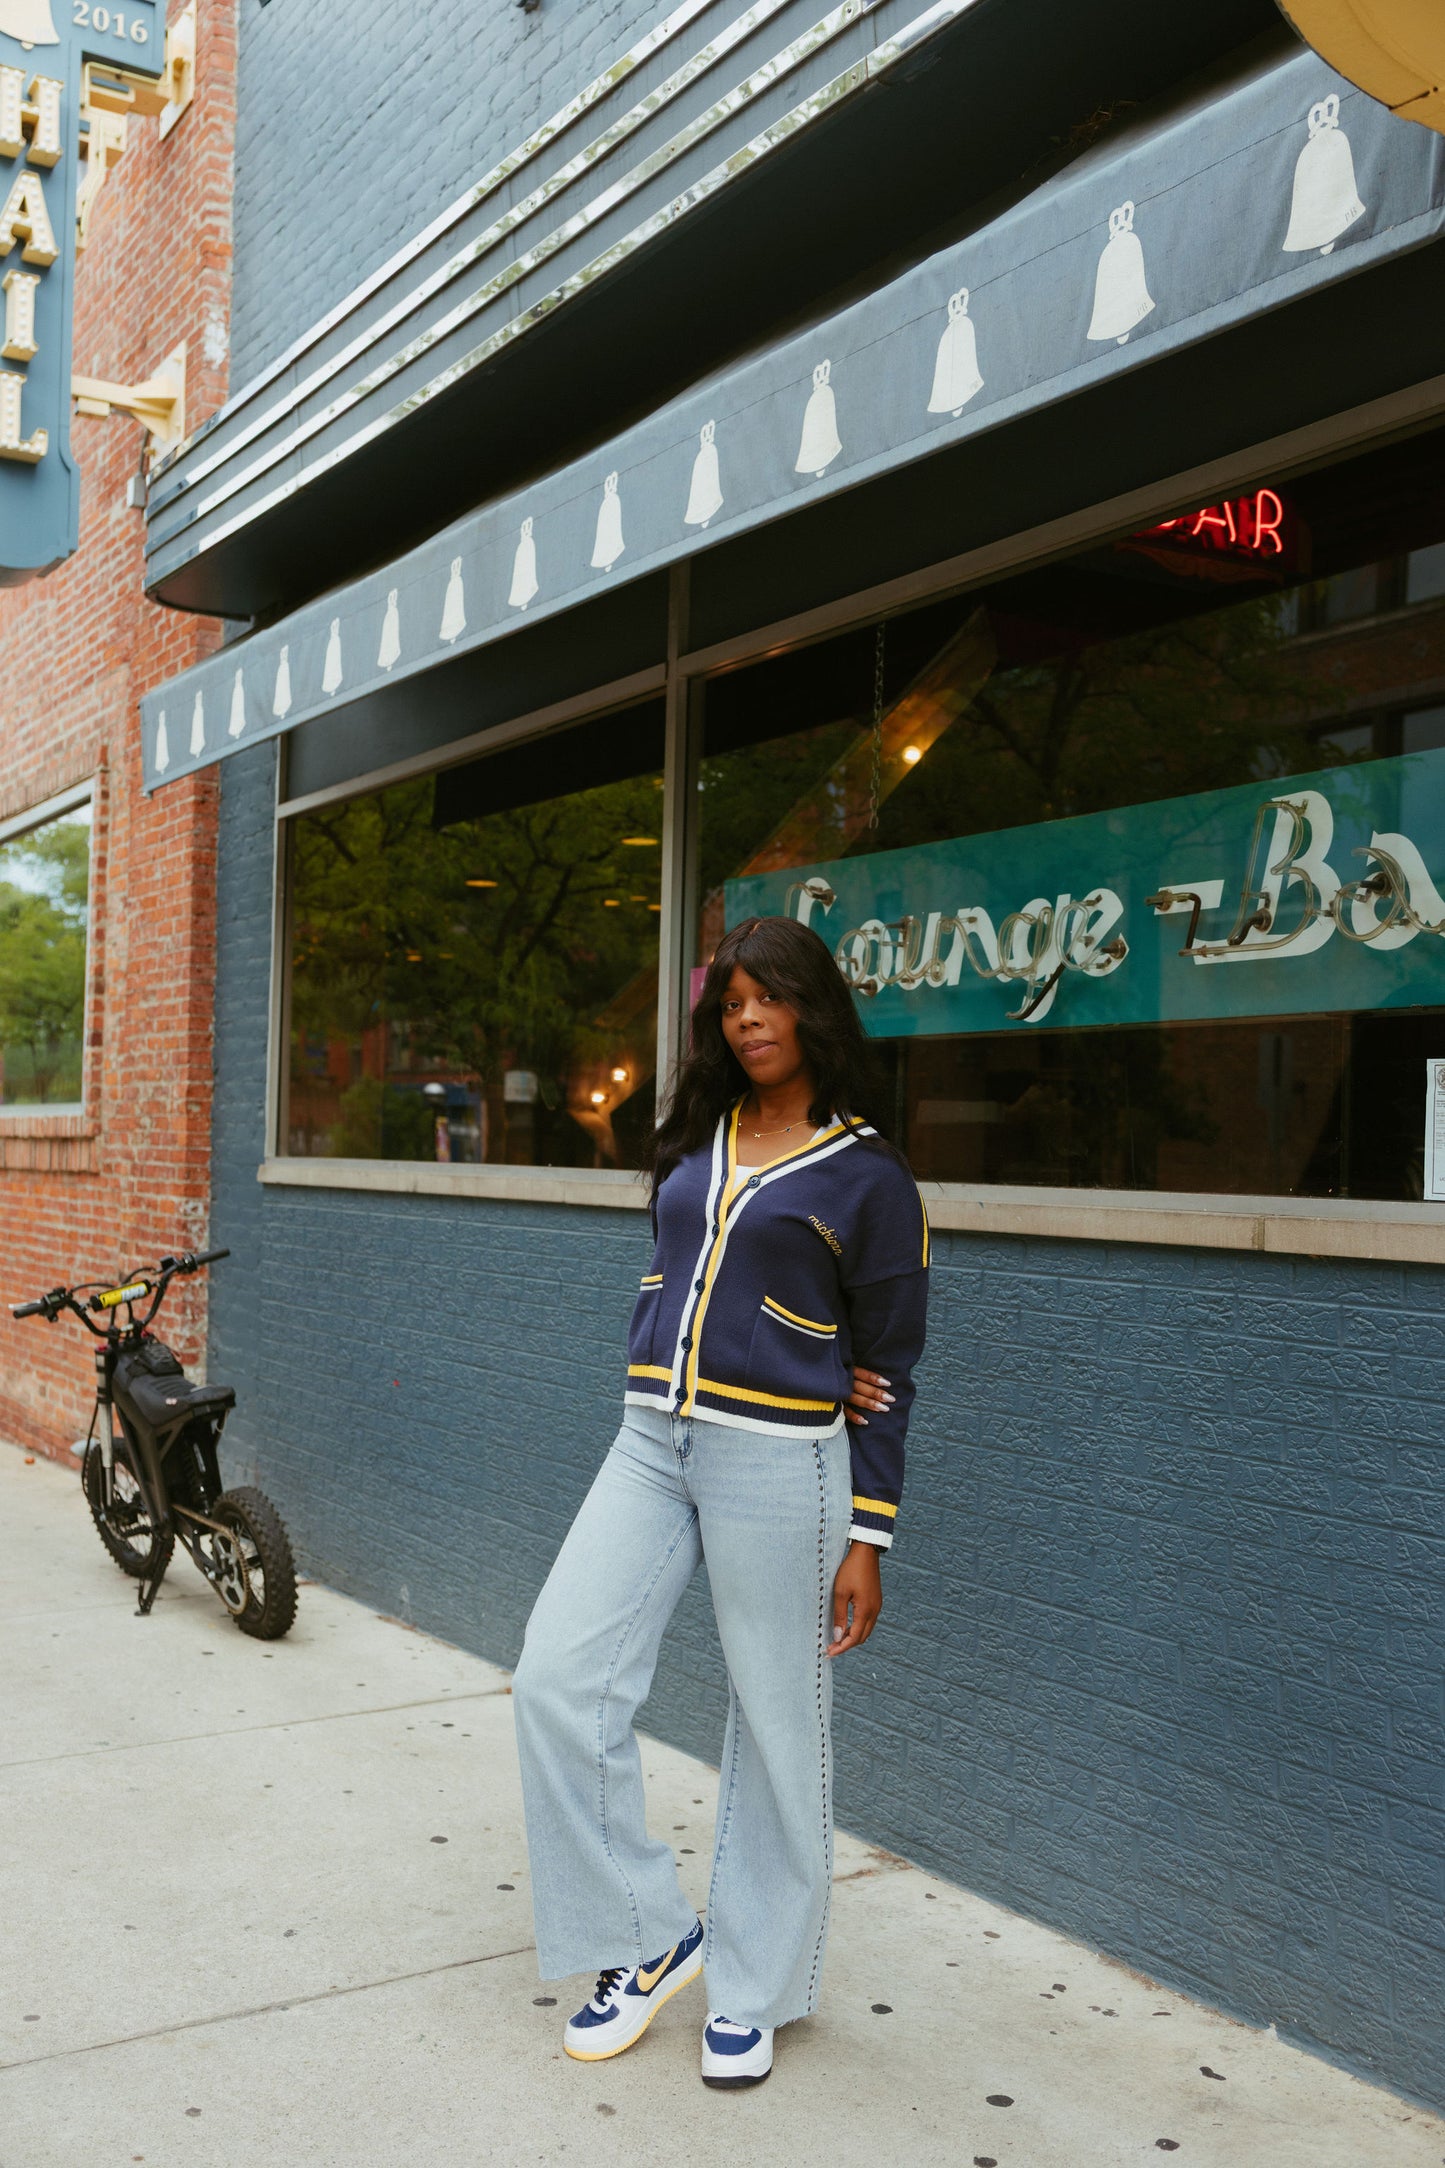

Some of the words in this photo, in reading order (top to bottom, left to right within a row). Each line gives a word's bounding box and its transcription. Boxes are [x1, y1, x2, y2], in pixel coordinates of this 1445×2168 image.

[72, 1, 149, 44] 2016
[0, 64, 64, 464] HAIL
[1158, 488, 1283, 553] AR
